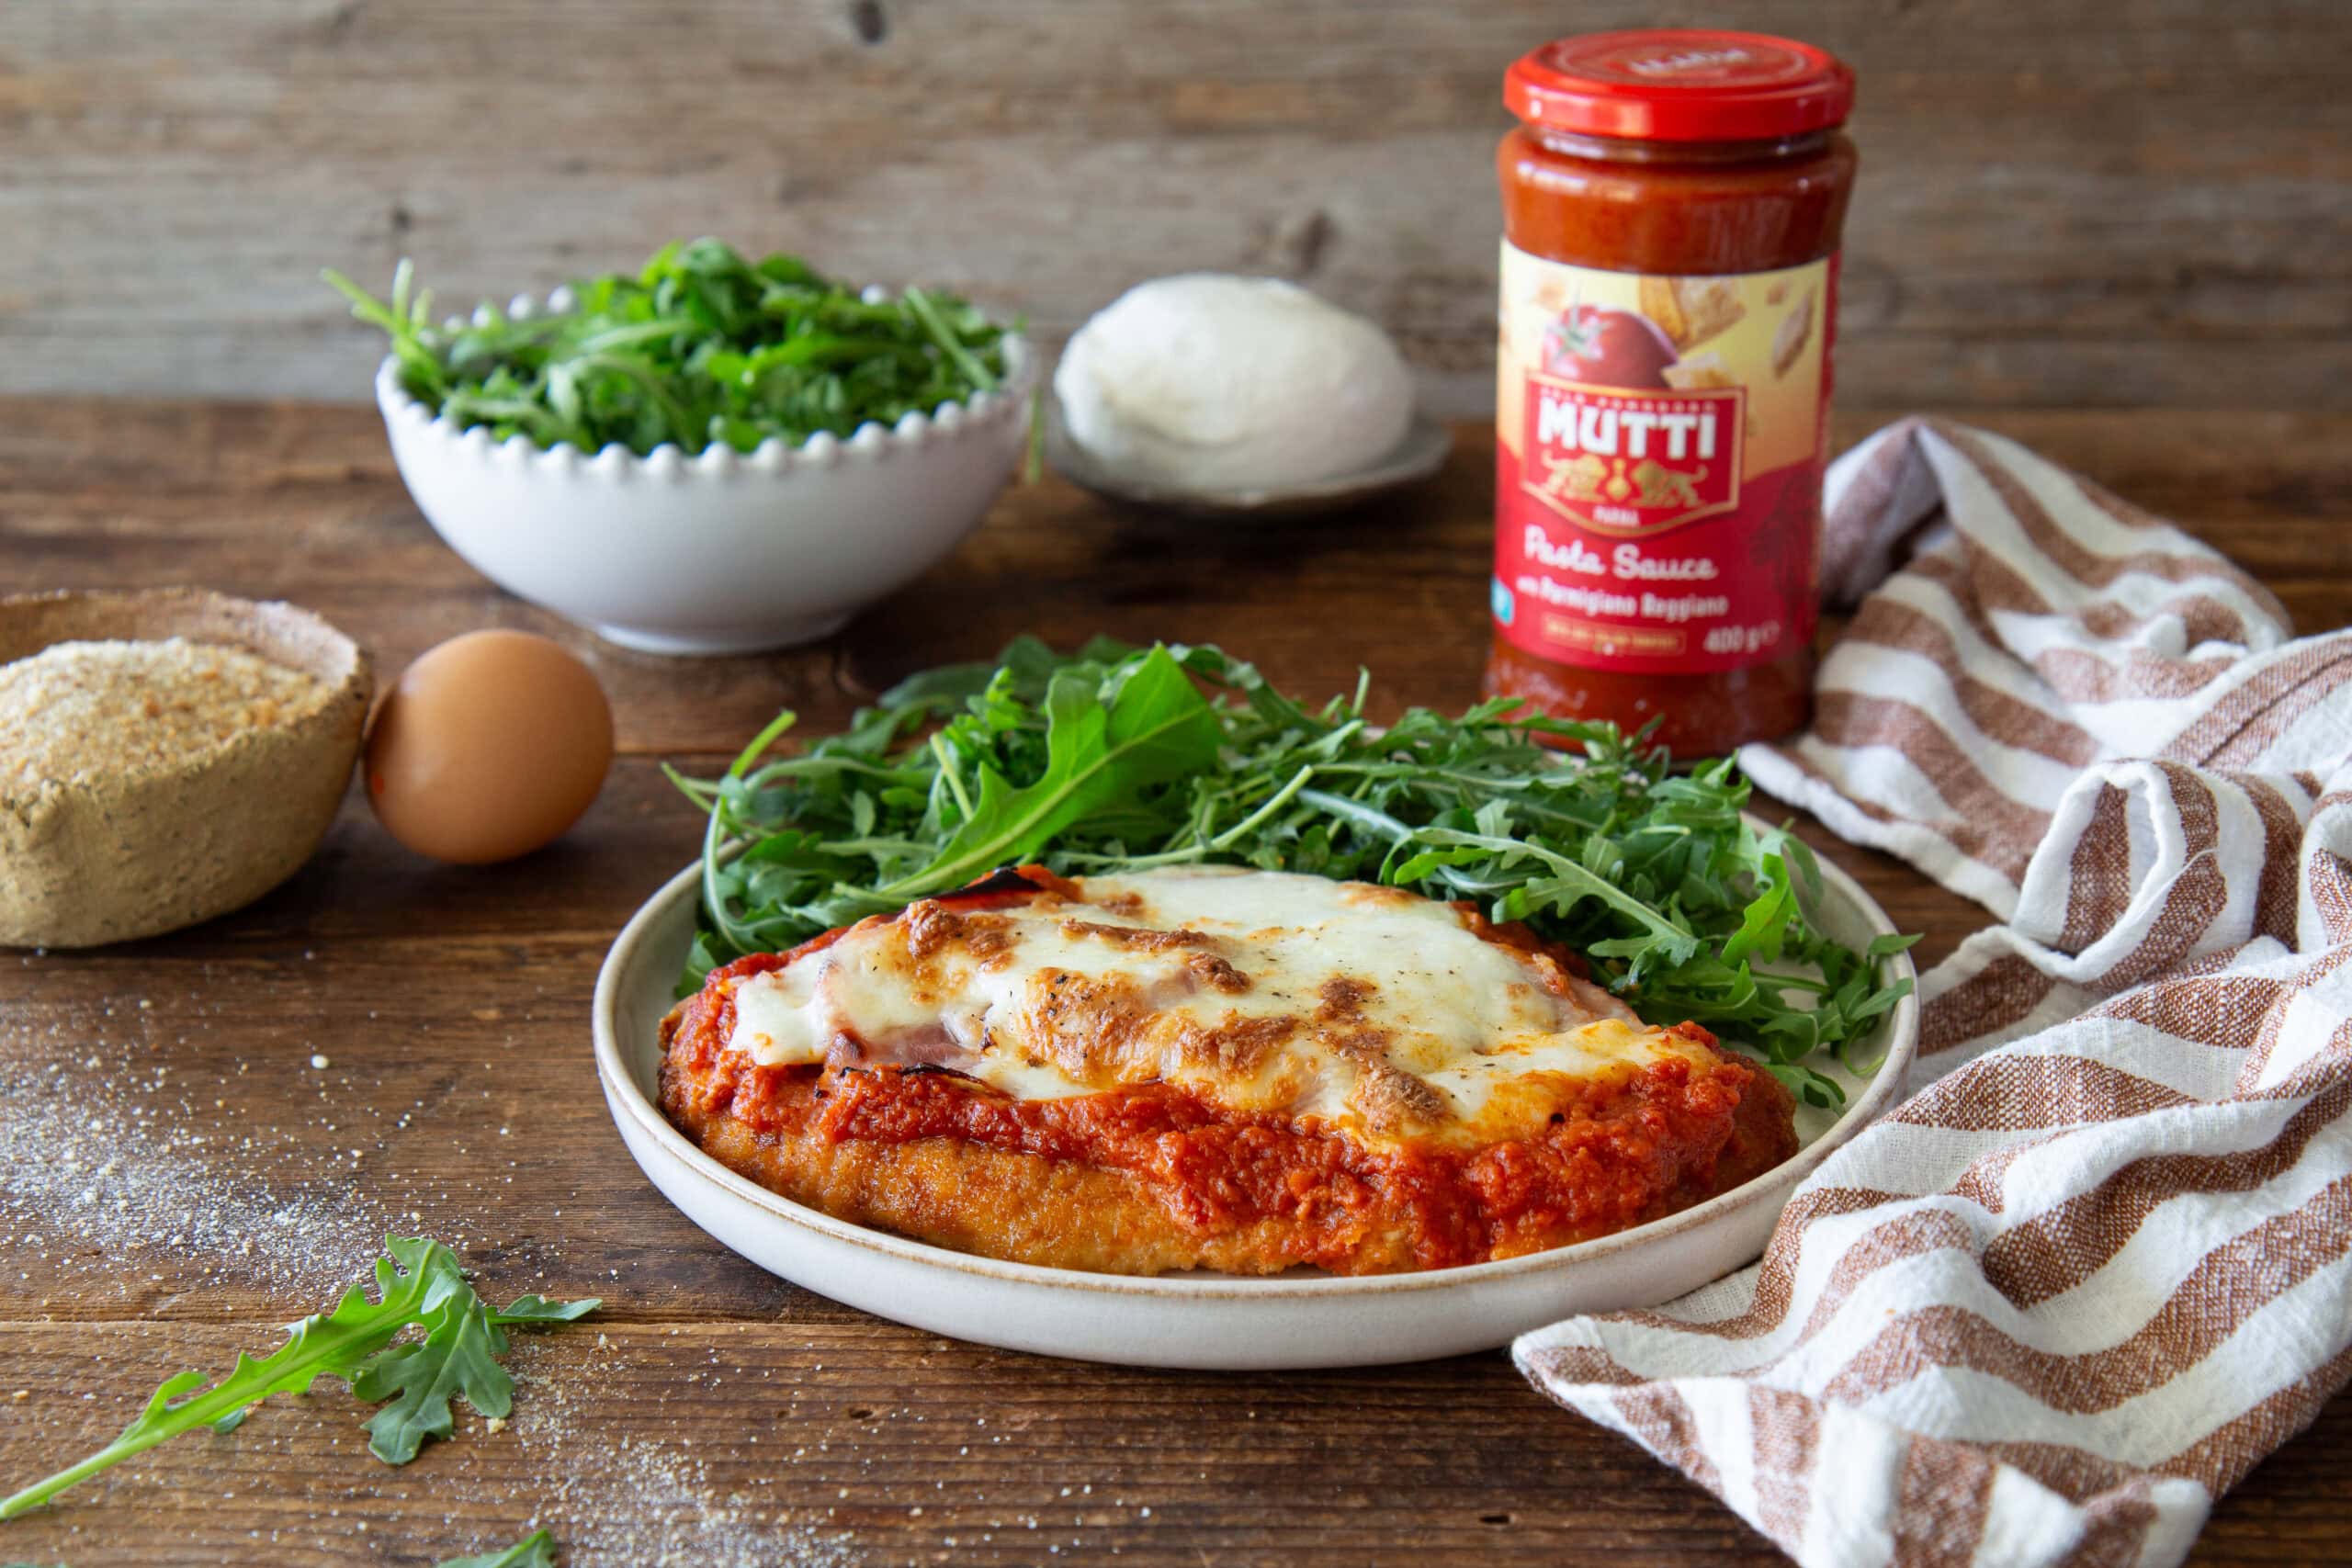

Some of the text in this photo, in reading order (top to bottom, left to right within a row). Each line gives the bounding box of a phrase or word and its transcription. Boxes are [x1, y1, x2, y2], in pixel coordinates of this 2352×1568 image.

[1538, 397, 1716, 459] MUTTI
[1523, 524, 1718, 580] Pasta Sauce
[1540, 576, 1637, 616] Parmigiano
[1640, 592, 1728, 622] Reggiano
[1703, 626, 1744, 654] 400
